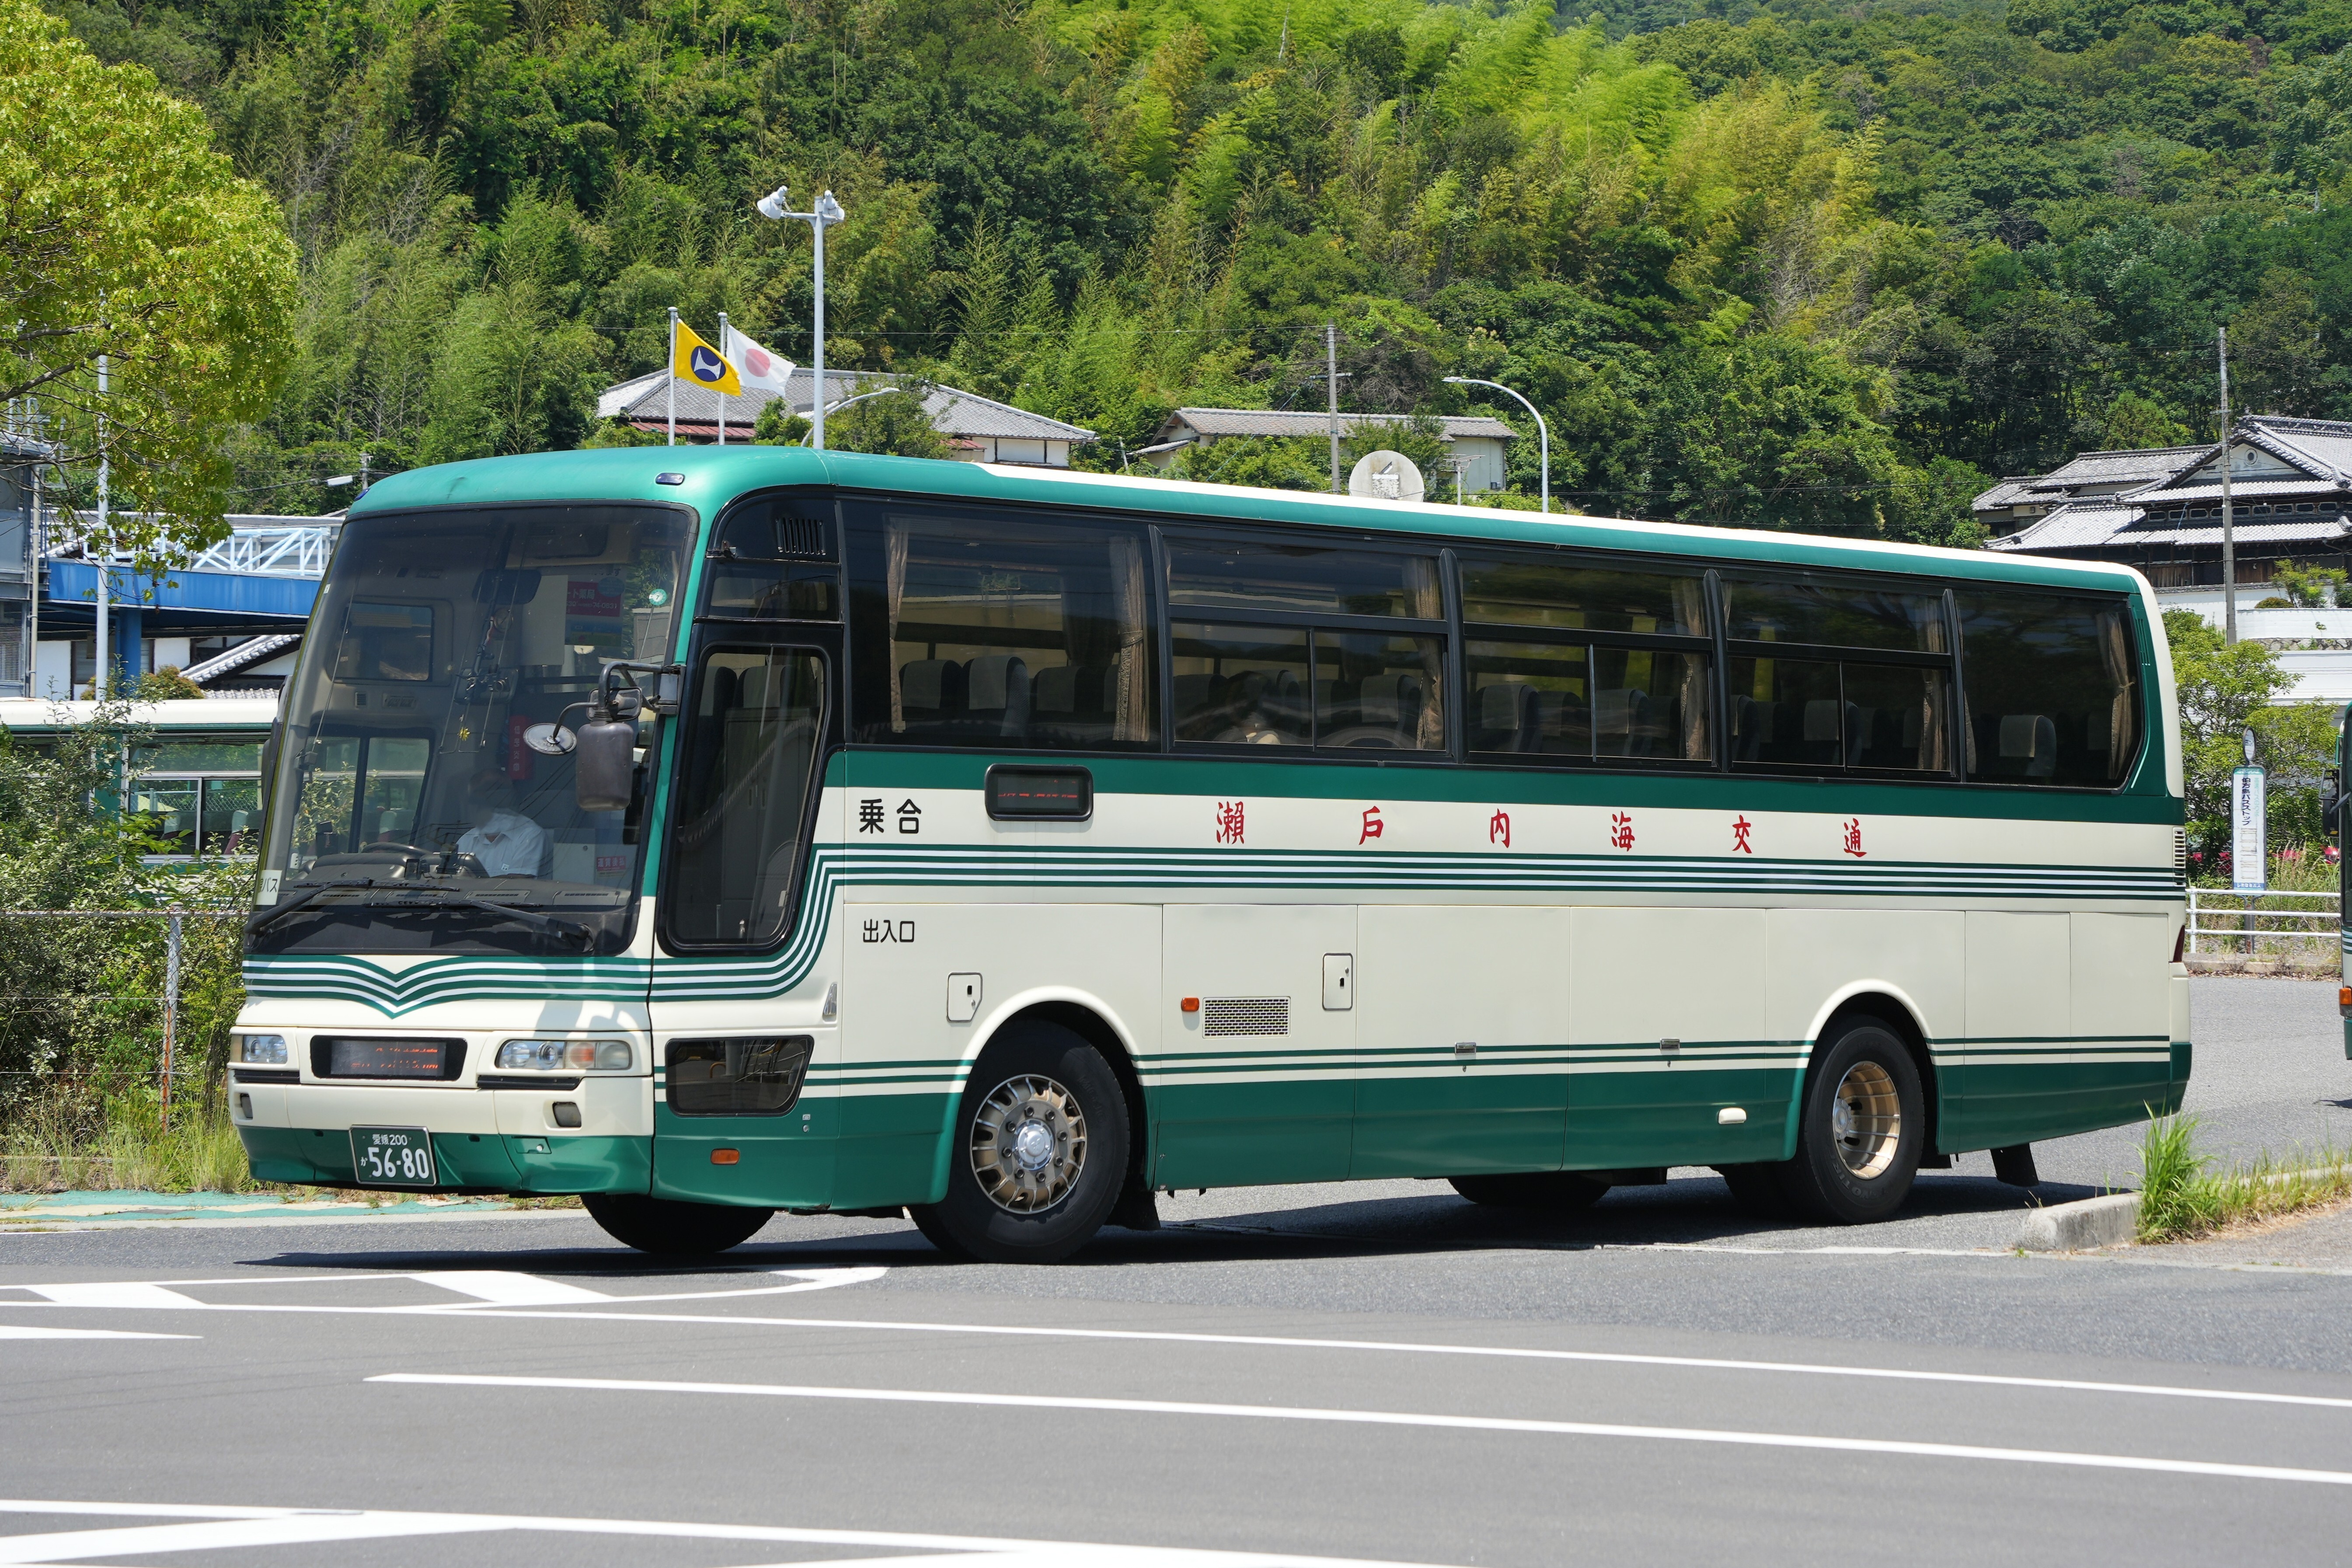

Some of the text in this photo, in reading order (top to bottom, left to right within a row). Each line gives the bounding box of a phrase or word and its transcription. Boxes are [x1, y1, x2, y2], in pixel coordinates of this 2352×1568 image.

[859, 798, 921, 834] 乗合
[2242, 777, 2251, 826] 伯方島バスストップ
[863, 919, 915, 943] 出入口
[368, 1146, 429, 1179] 56-80
